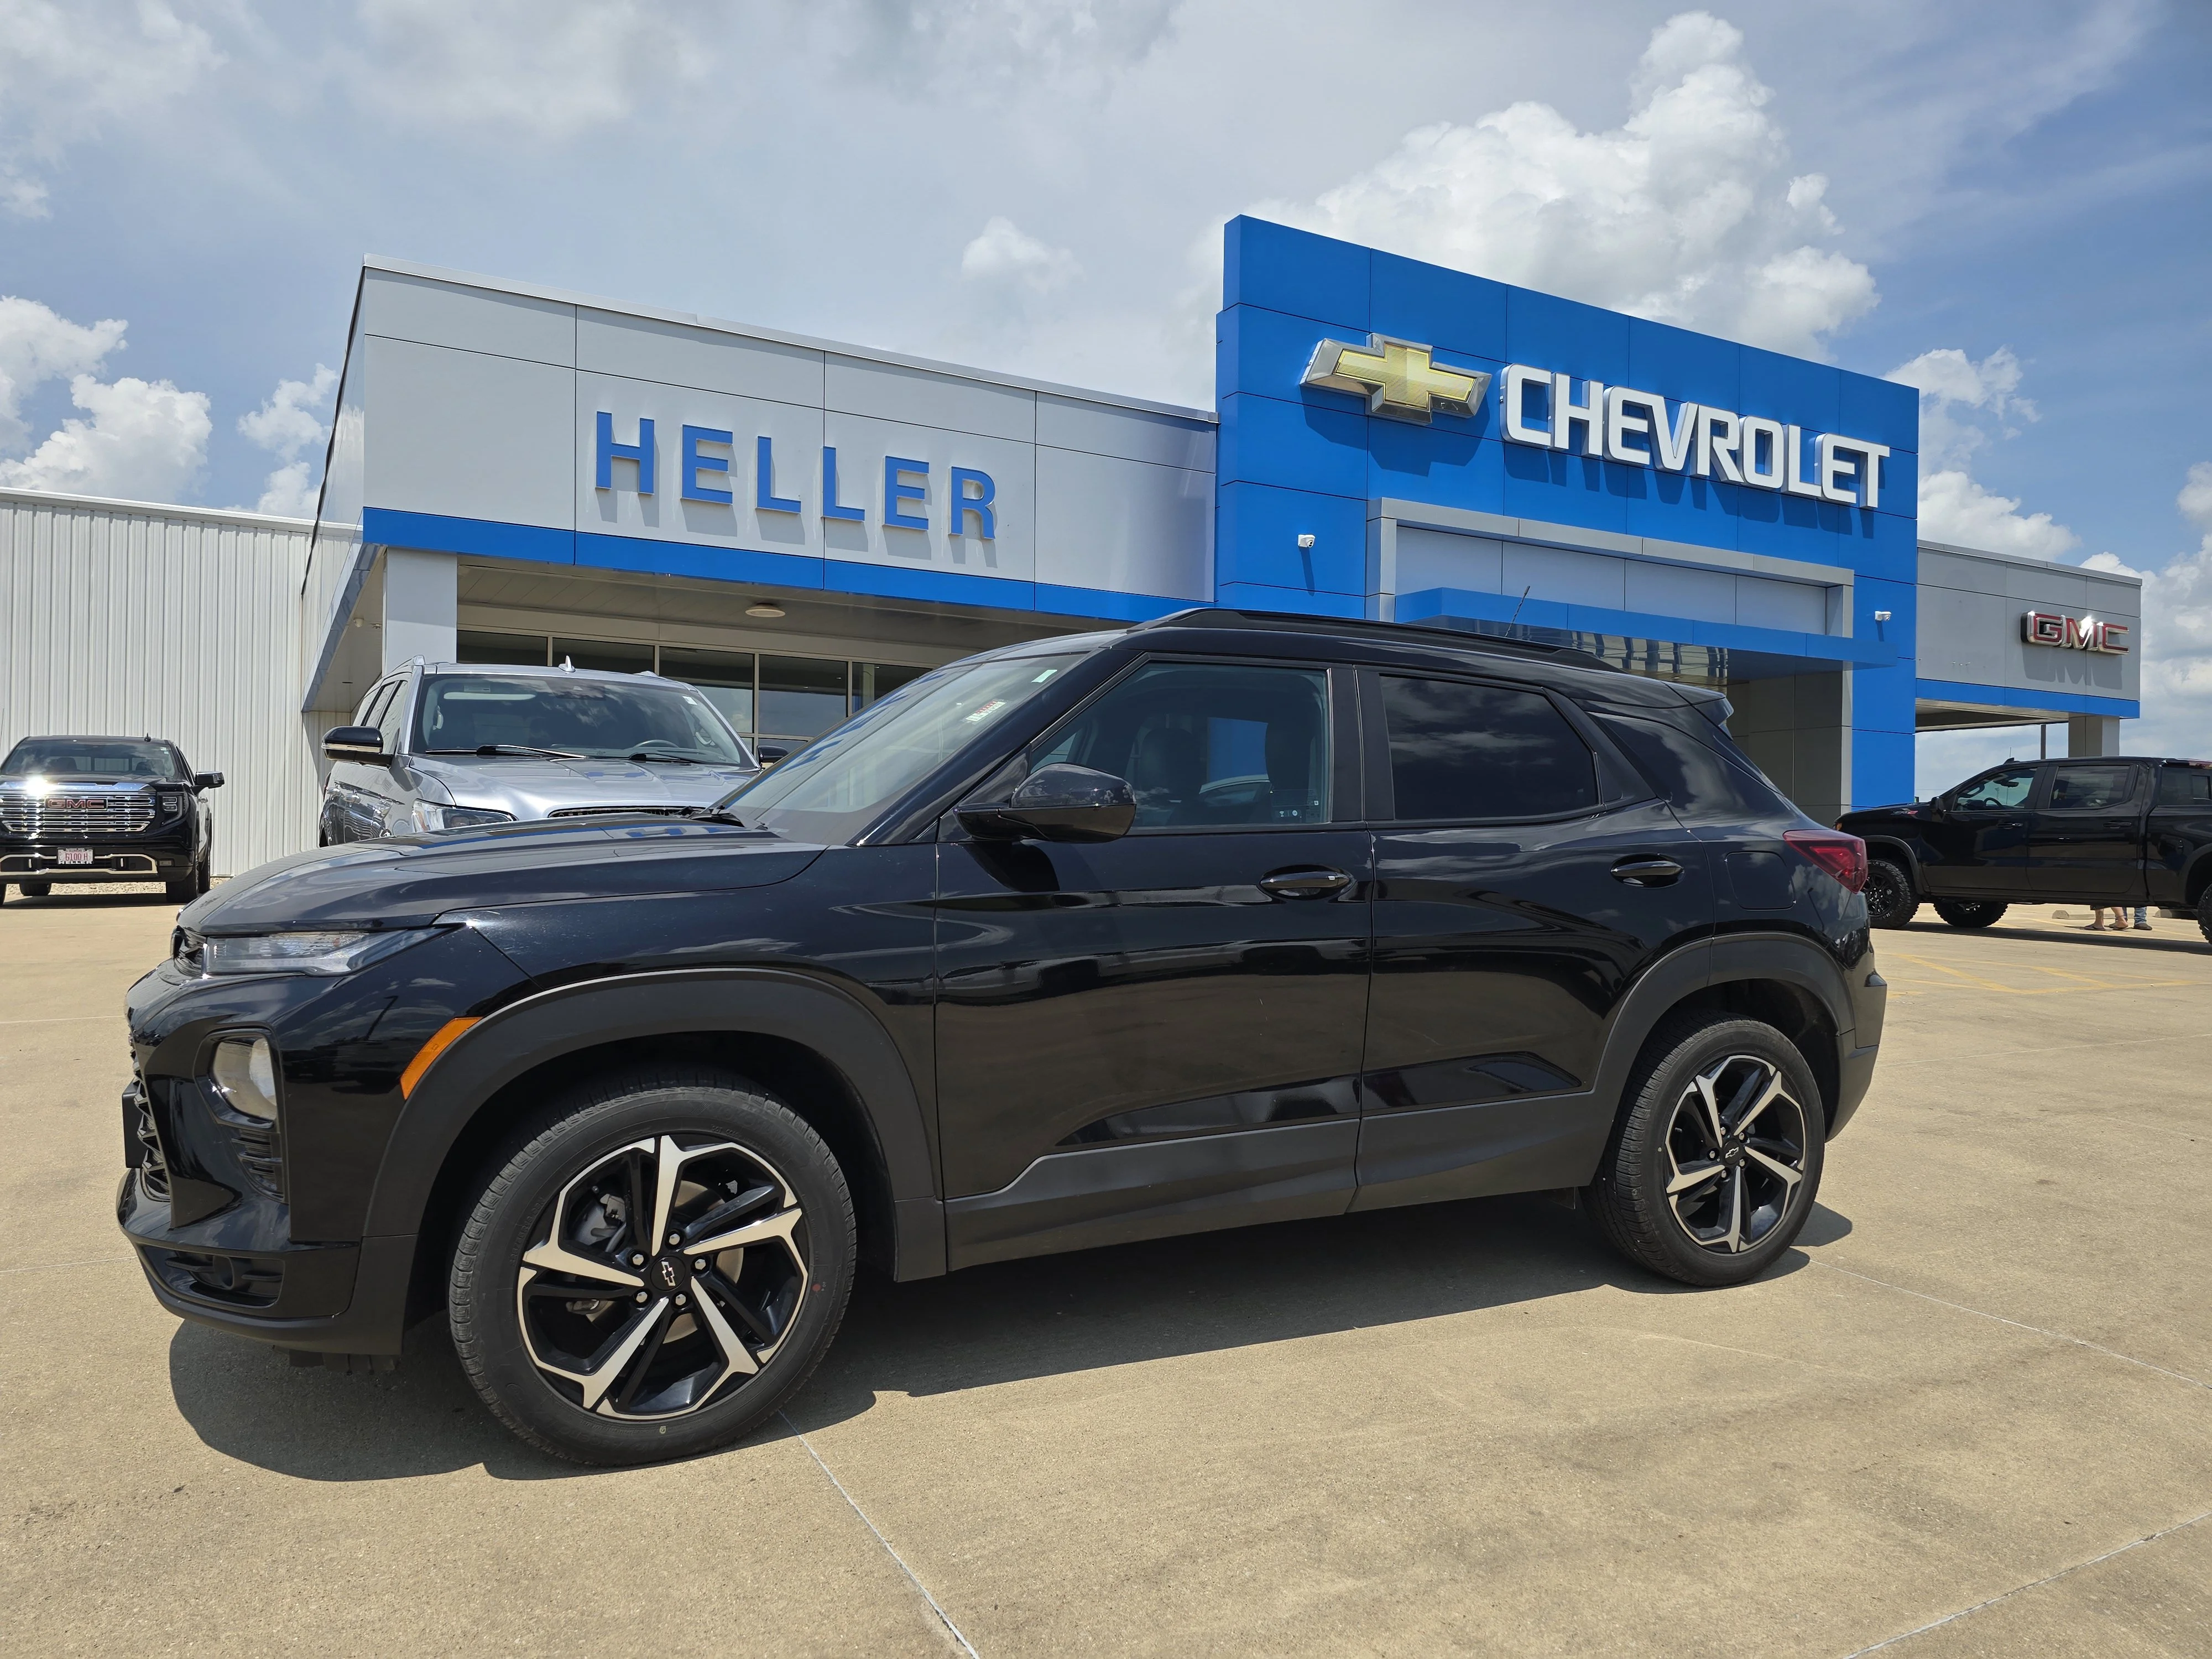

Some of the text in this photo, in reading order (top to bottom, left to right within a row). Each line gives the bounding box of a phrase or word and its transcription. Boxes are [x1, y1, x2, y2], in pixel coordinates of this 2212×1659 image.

[1500, 363, 1890, 508] CHEVROLET
[595, 411, 995, 539] HELLER
[2021, 611, 2129, 655] GMC
[48, 799, 104, 808] GMC
[65, 853, 82, 861] 6100
